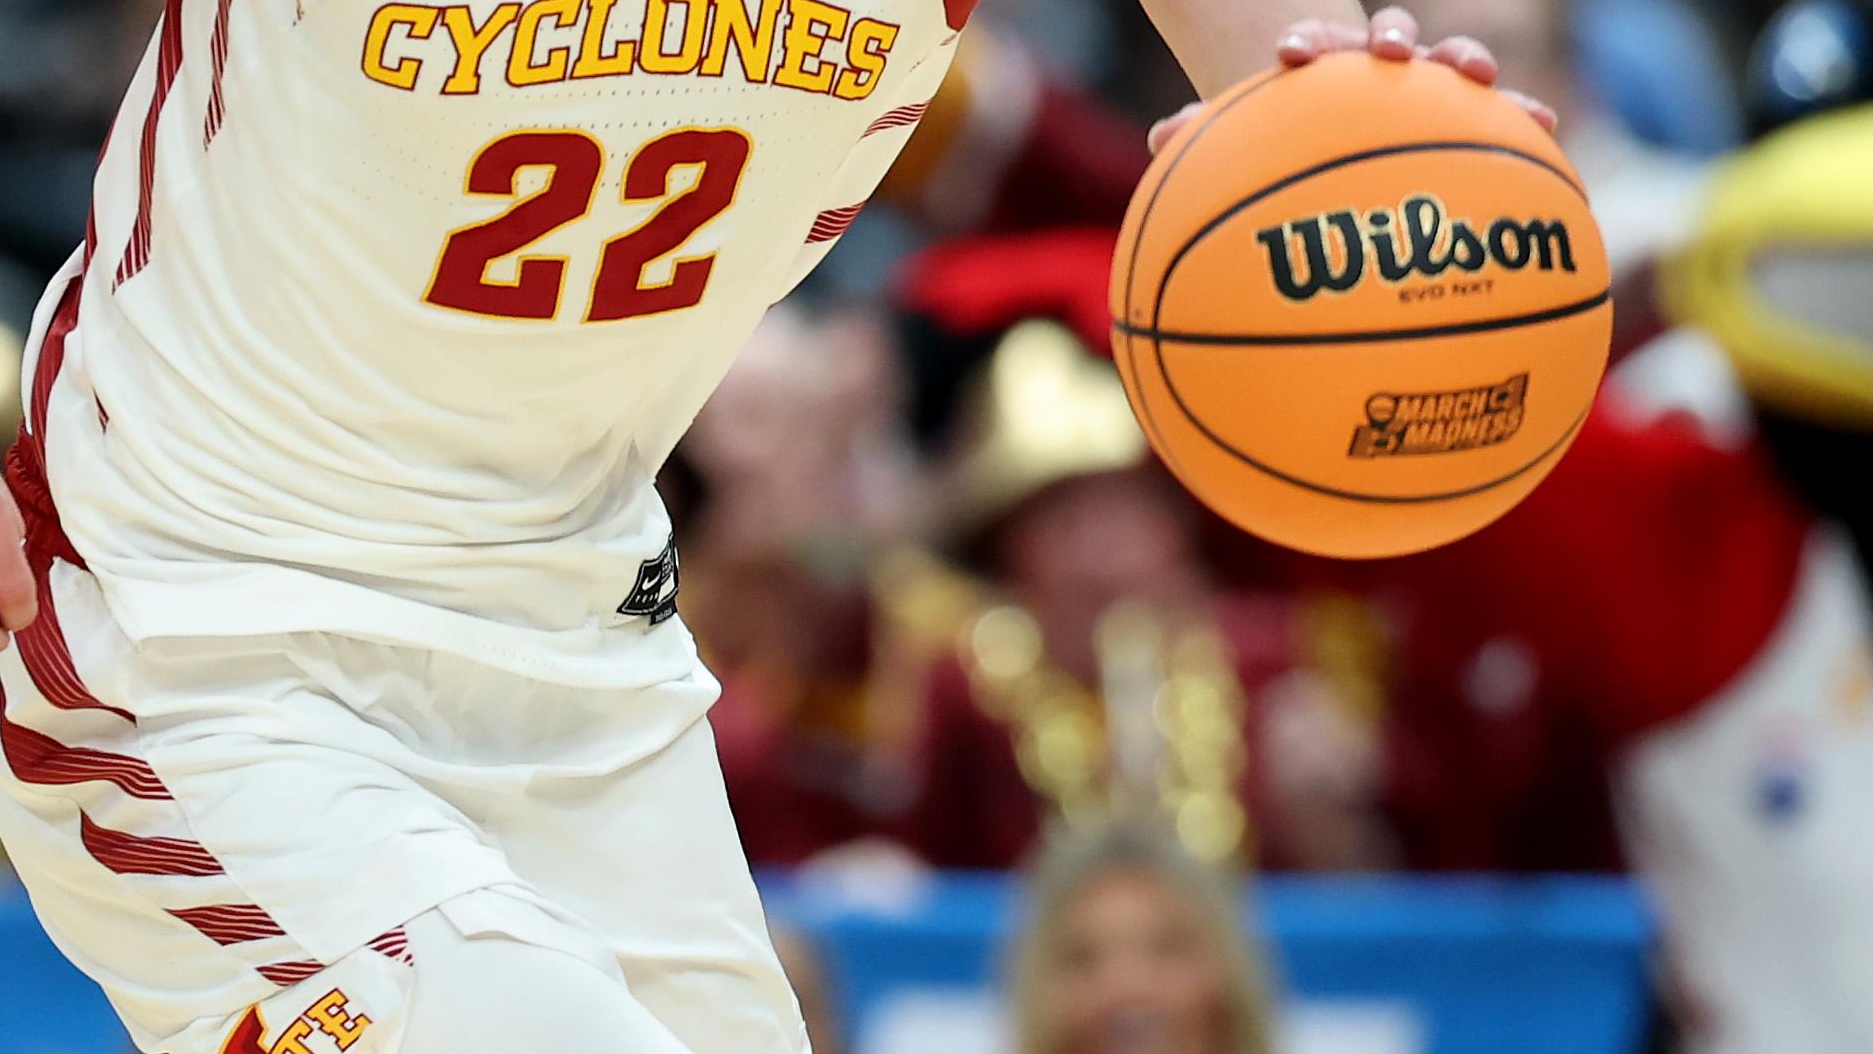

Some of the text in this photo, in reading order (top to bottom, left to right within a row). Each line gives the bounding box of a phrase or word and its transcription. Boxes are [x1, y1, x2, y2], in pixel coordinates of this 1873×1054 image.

[420, 126, 754, 324] 22
[1254, 194, 1577, 303] Wilson
[1397, 390, 1488, 420] MARCH
[1404, 406, 1523, 450] MADNESS
